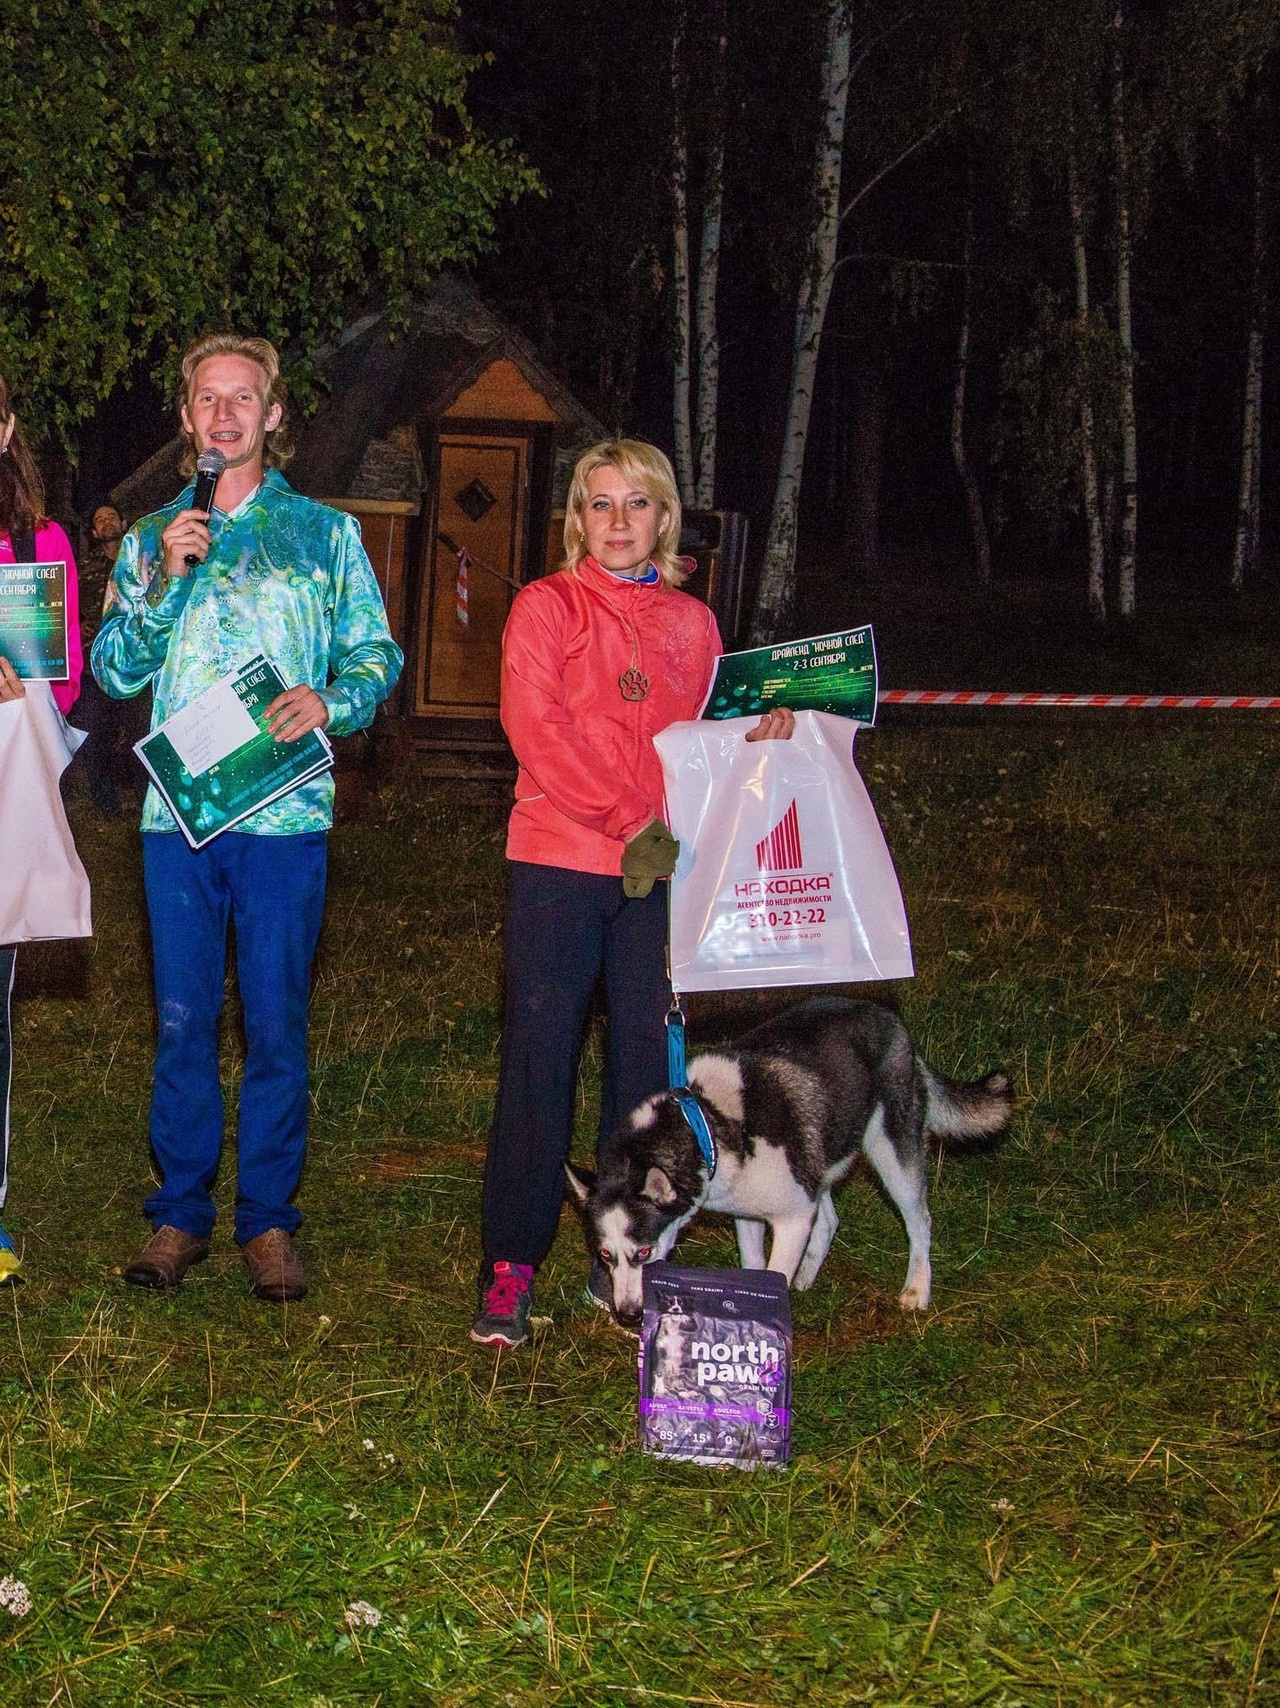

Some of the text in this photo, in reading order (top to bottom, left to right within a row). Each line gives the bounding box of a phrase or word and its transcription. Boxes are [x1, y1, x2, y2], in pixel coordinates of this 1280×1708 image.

[0, 584, 37, 596] СЕНТЯБРЯ
[771, 644, 810, 661] ДРАЙЛЕНД
[793, 652, 846, 671] 2-3 СЕНТЯБРЯ
[735, 876, 830, 897] НАХОДКА
[775, 895, 832, 907] НЕДВИЖИМОСТИ
[749, 908, 826, 928] 310-22-22
[691, 1340, 779, 1363] north
[697, 1362, 760, 1386] paw
